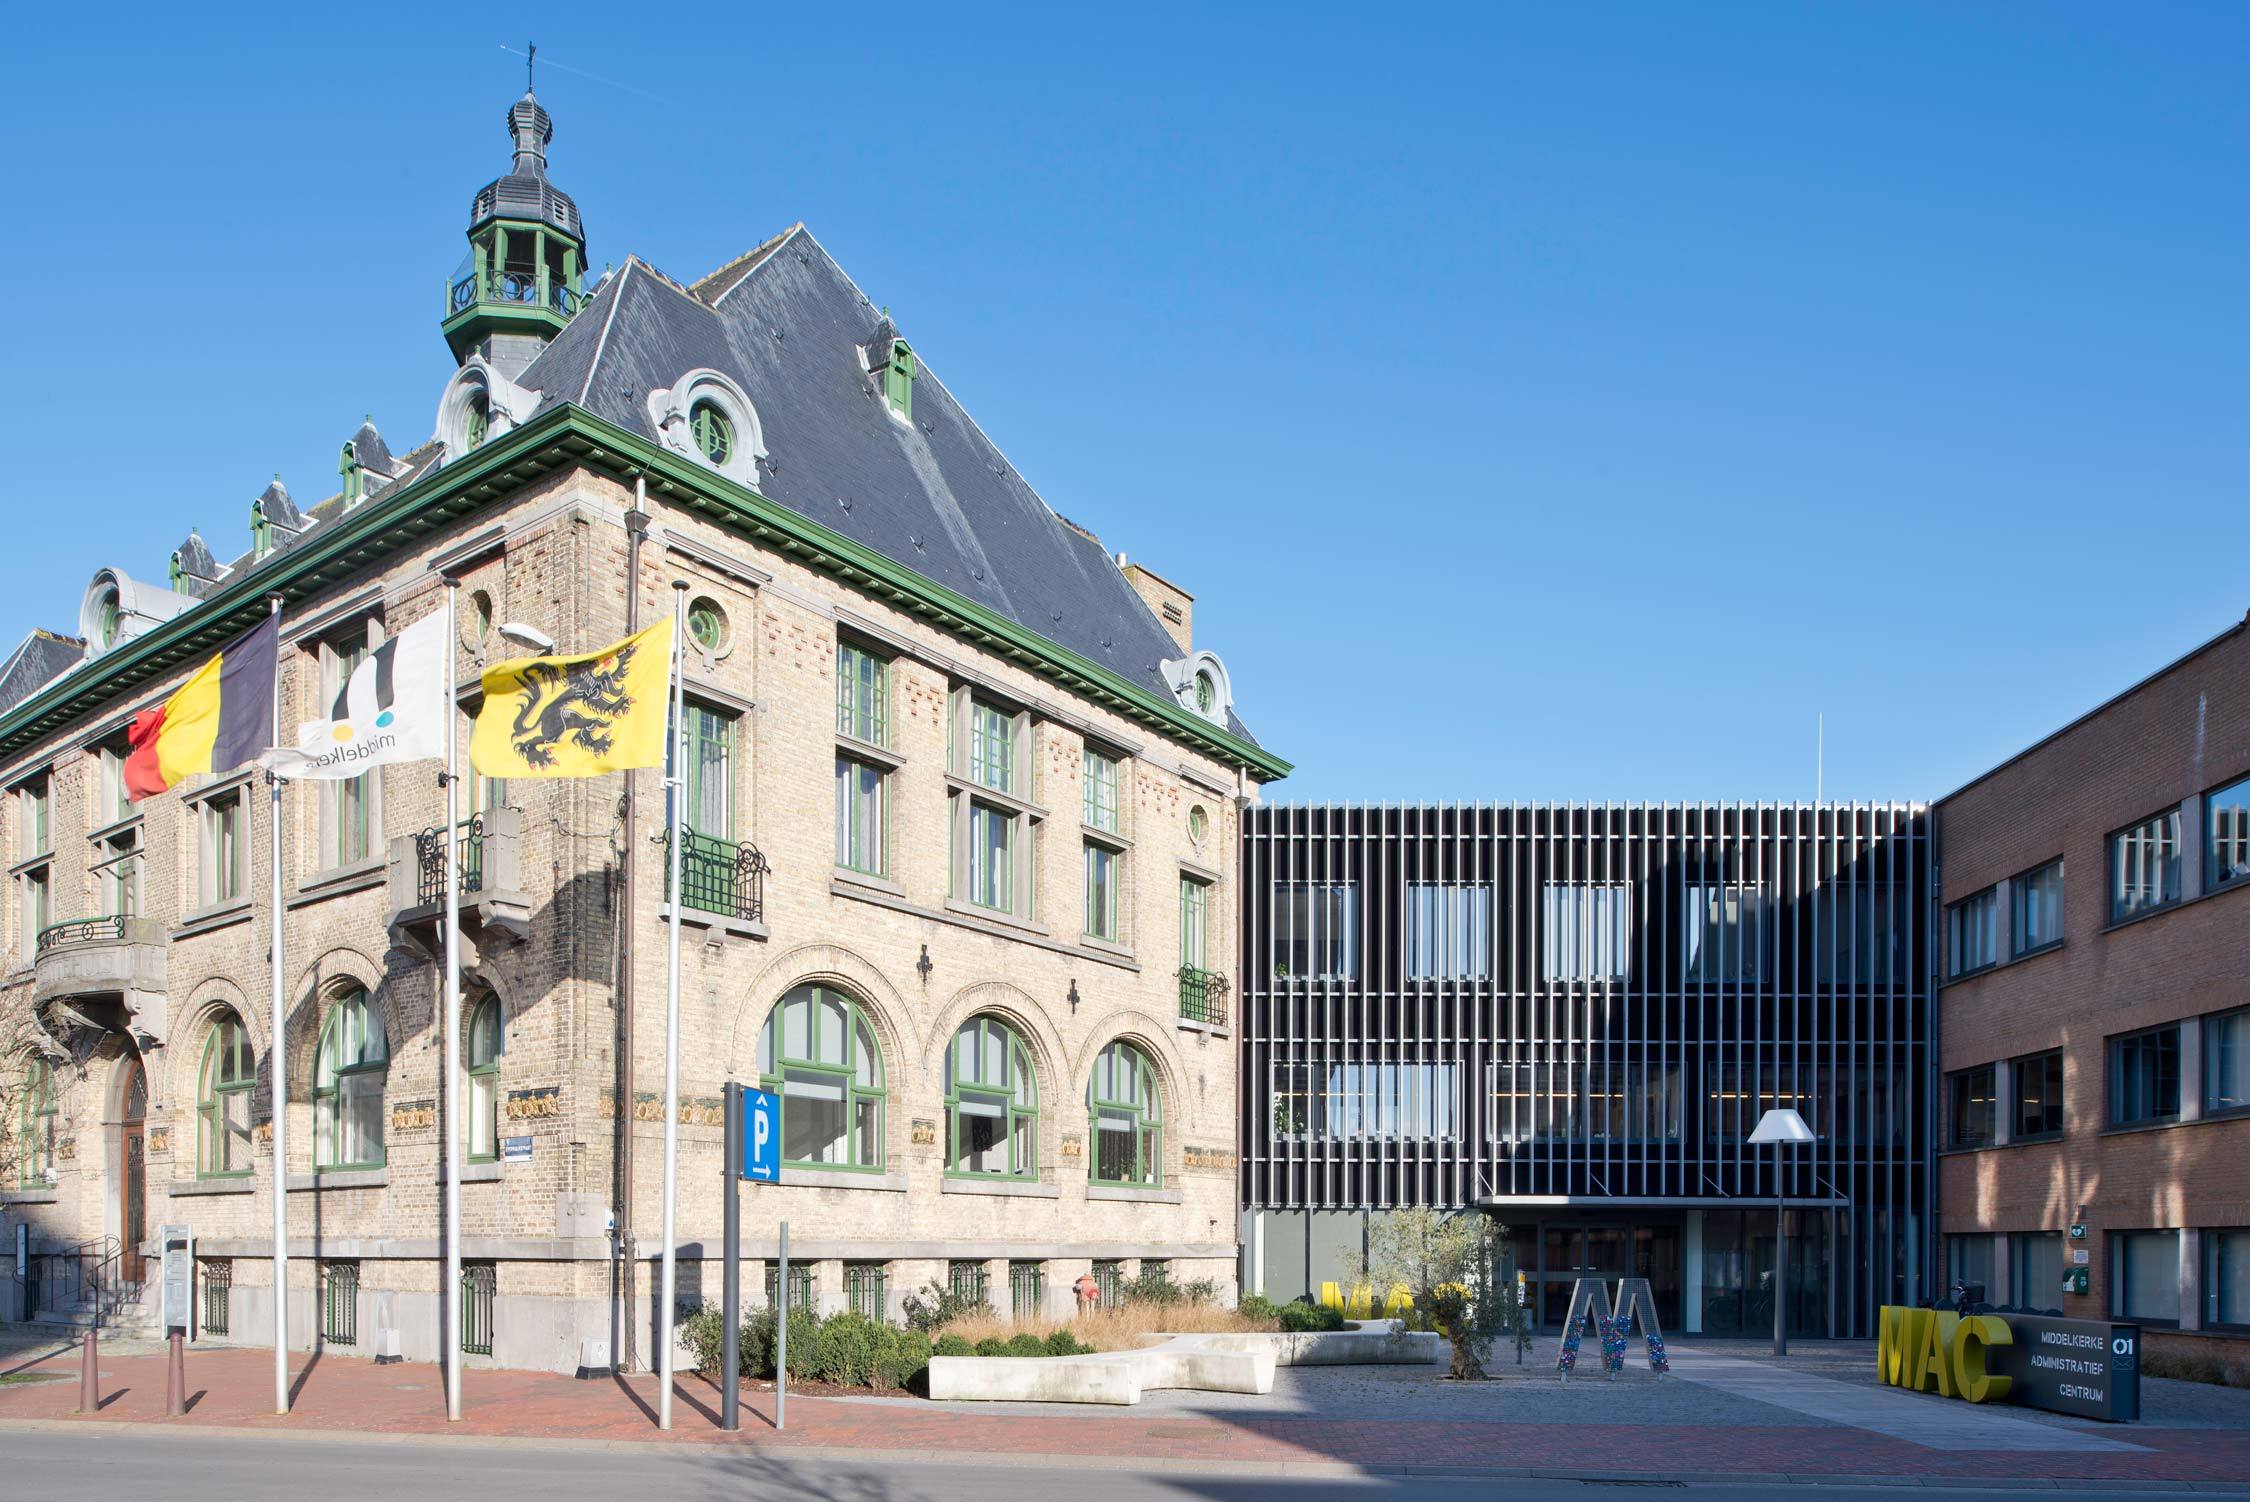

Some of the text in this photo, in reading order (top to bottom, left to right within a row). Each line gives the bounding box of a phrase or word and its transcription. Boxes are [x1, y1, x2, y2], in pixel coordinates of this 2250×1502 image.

[754, 1108, 769, 1163] P
[2041, 1331, 2104, 1350] MIDDELKERKE
[1877, 1305, 2014, 1403] MAC
[2031, 1355, 2104, 1375] ADMINISTRATIEF
[2059, 1383, 2104, 1402] CENTRUM
